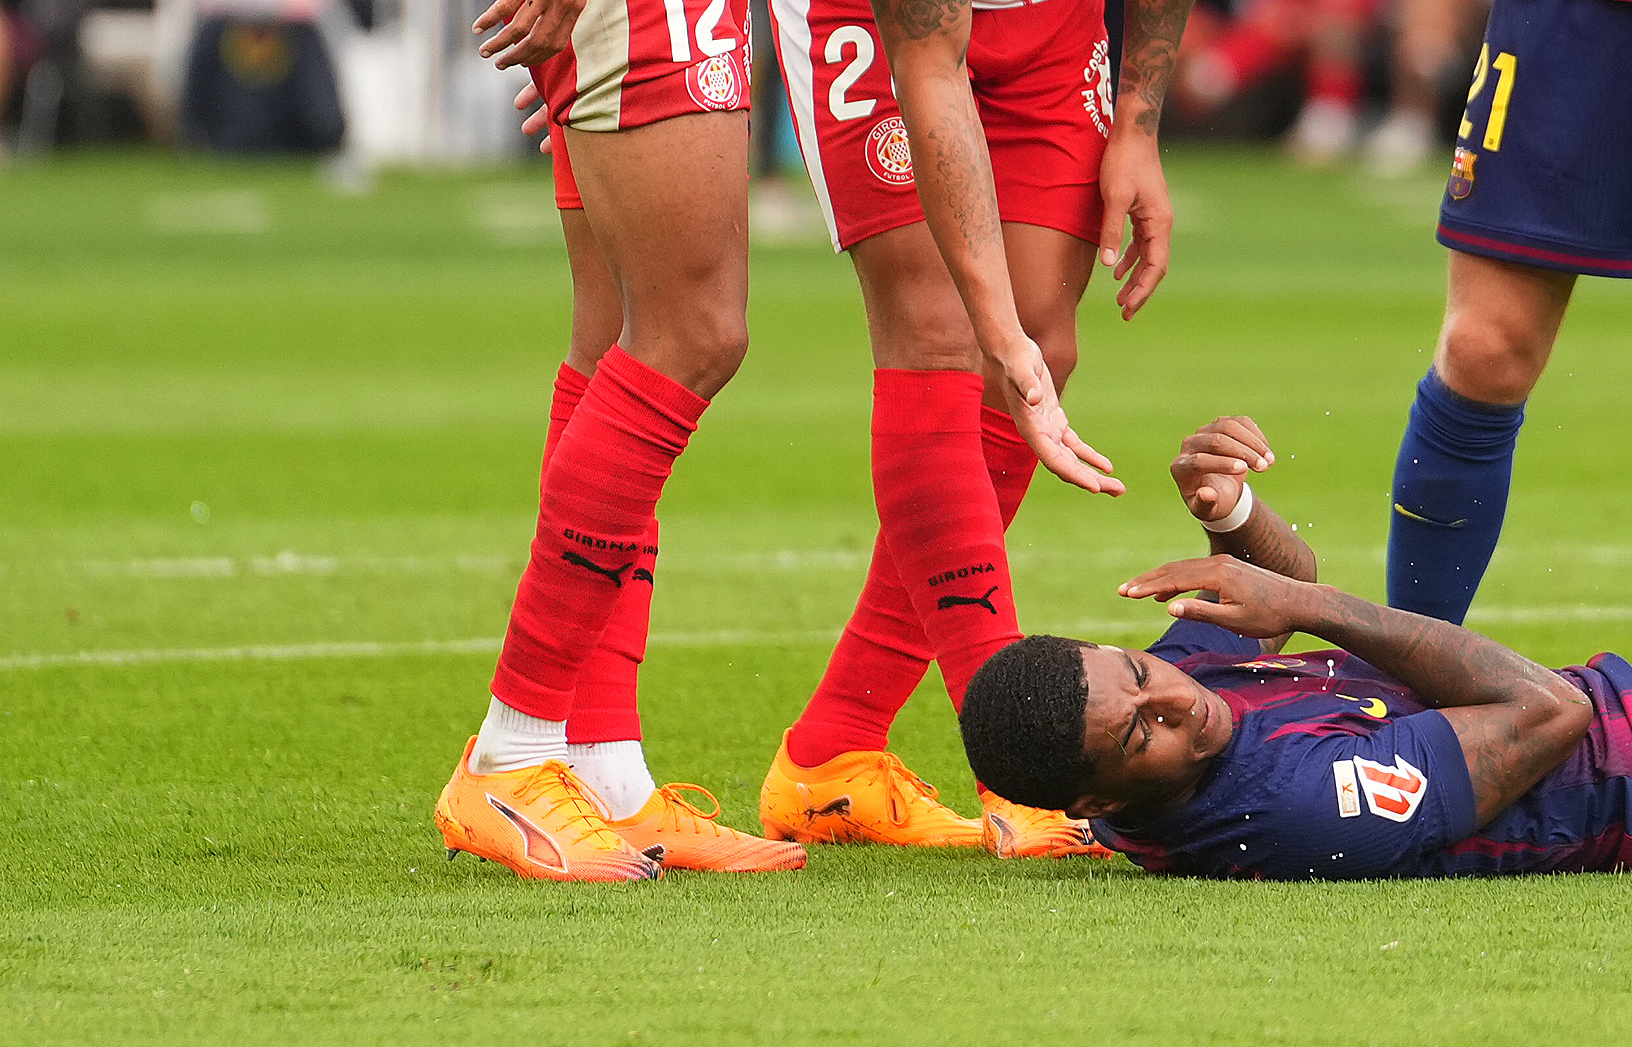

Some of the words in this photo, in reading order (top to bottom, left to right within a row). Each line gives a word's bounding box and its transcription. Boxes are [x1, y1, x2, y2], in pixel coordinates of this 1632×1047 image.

[824, 25, 897, 121] 2
[1081, 89, 1109, 139] Pirineu
[1458, 42, 1517, 152] 21
[883, 171, 910, 181] FUTBOL
[563, 528, 638, 552] GIRONA
[928, 562, 995, 587] GIRONA
